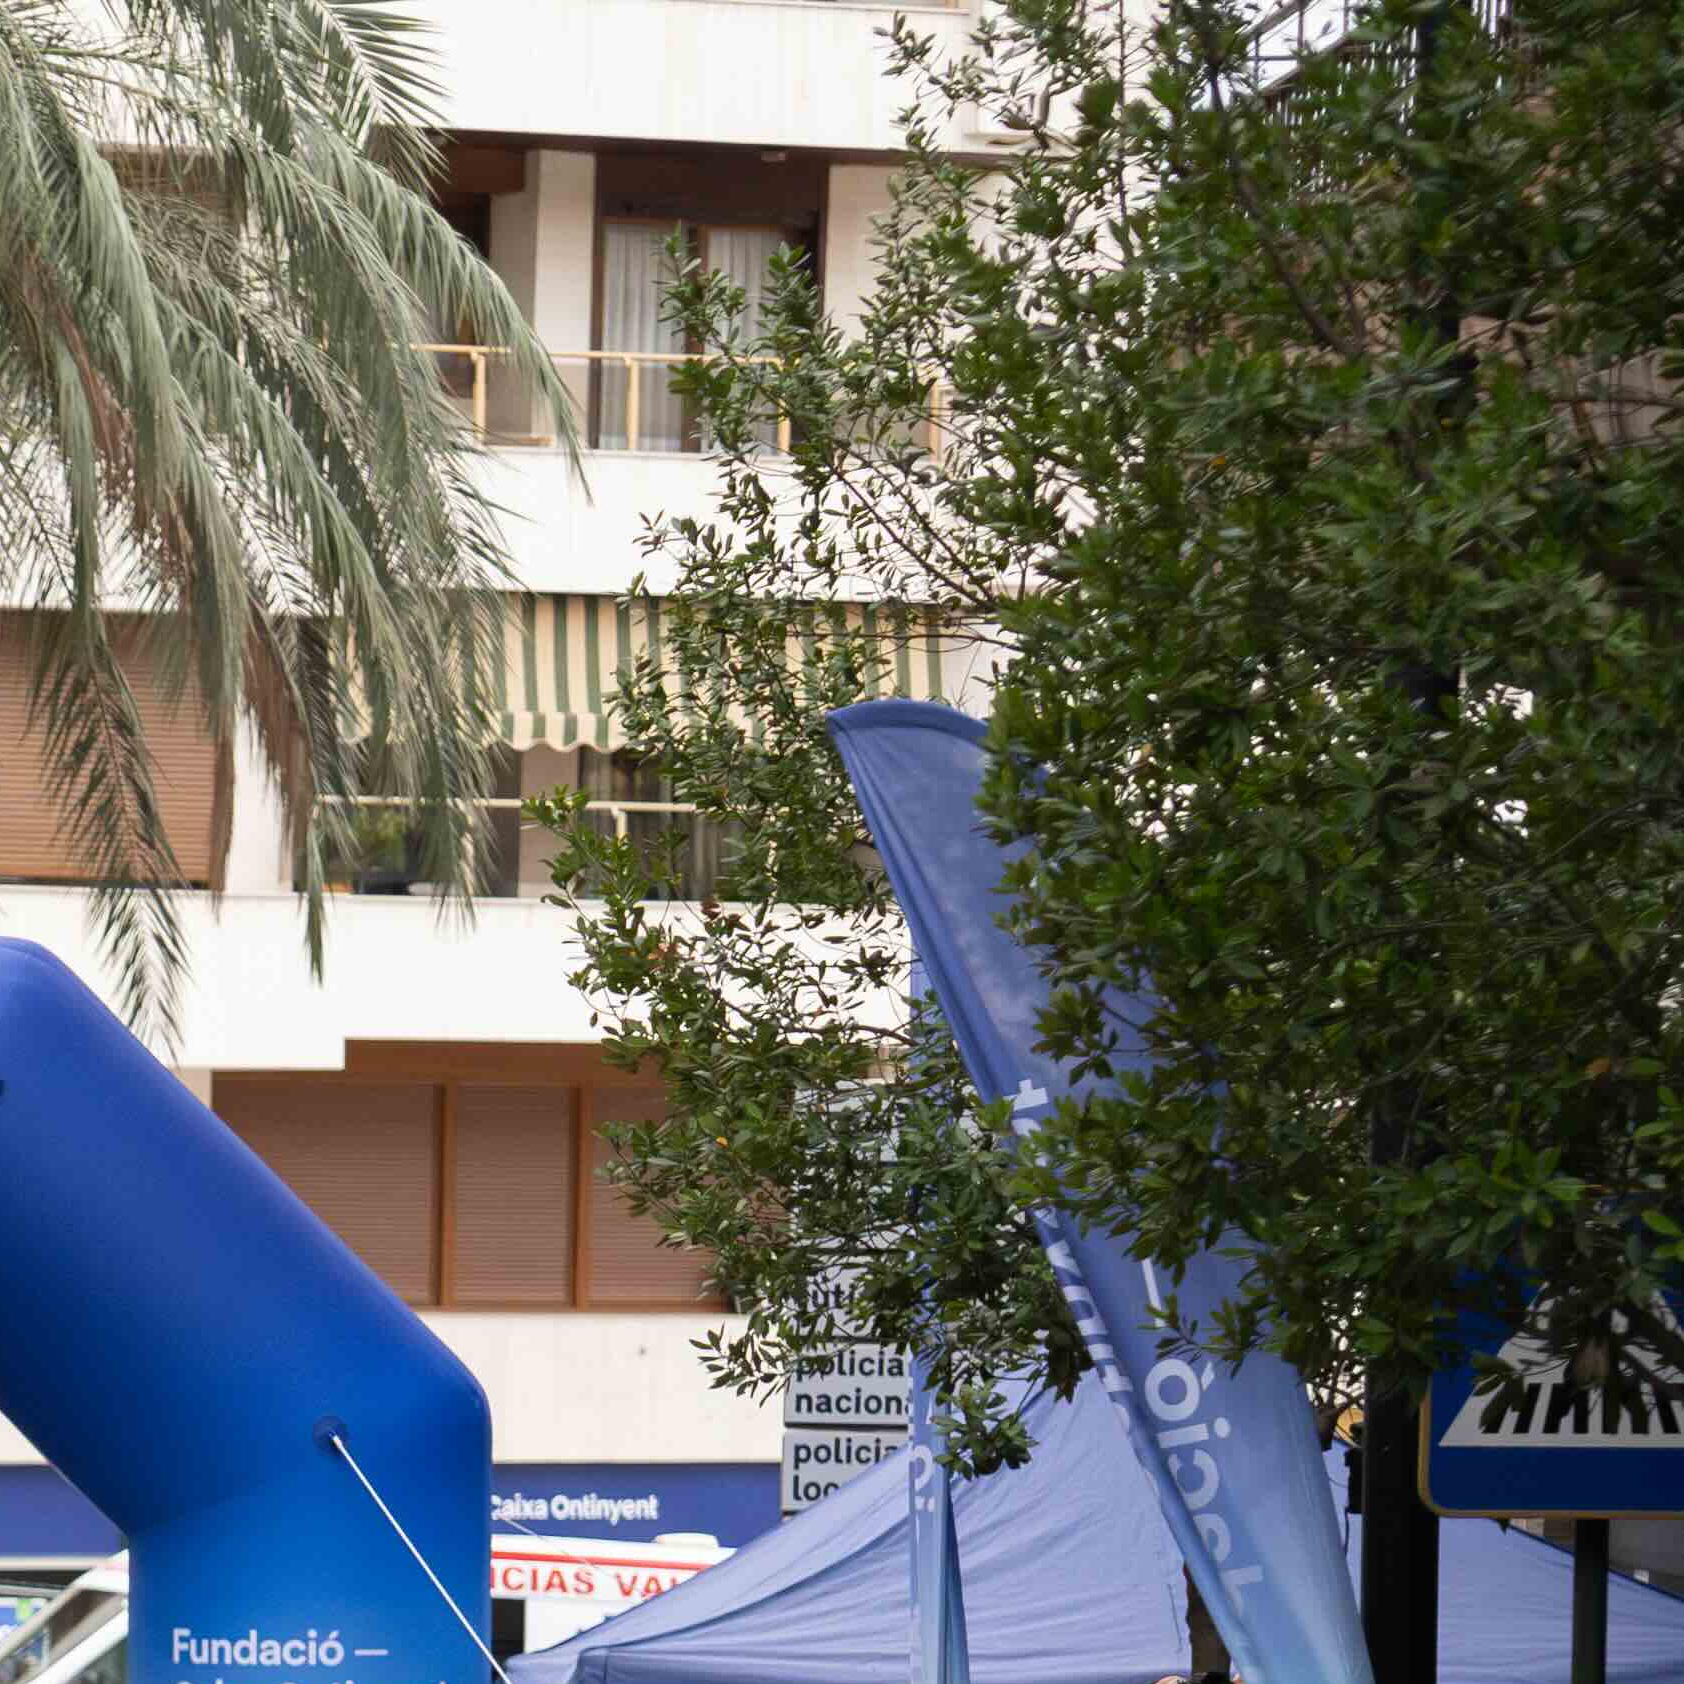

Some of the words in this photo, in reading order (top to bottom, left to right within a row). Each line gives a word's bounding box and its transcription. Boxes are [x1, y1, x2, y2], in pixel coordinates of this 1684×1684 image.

[794, 1386, 913, 1415] nacion
[550, 1494, 661, 1527] Ontinyent
[172, 1627, 345, 1667] Fundació
